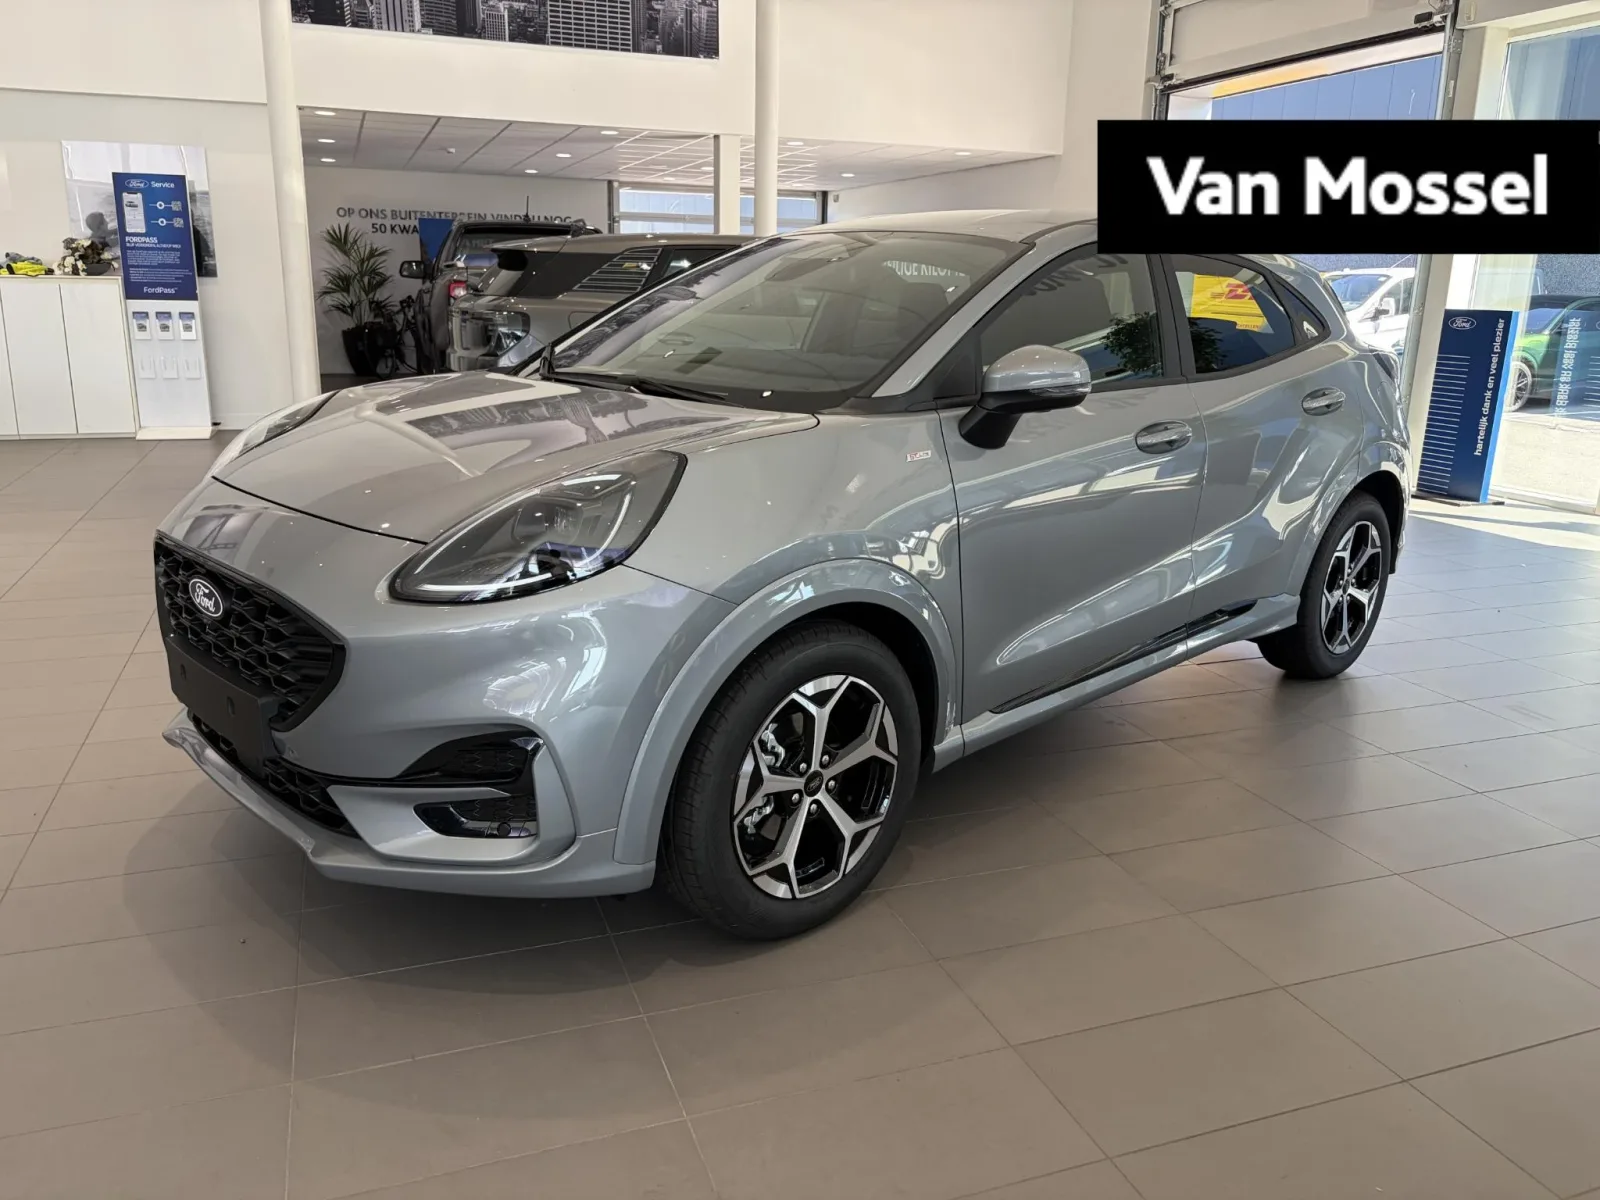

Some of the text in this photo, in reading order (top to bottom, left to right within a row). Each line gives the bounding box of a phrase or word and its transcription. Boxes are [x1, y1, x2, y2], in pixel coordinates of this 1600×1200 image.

[150, 181, 175, 189] Service
[336, 206, 355, 218] OP
[358, 208, 387, 220] ONS
[390, 209, 487, 221] BUITENTEREIN
[491, 213, 529, 221] VIND
[371, 222, 387, 234] 50
[125, 236, 158, 244] FORDPASS
[1452, 318, 1472, 328] Ford
[1473, 318, 1505, 456] hartelijk dank en veel plezier
[194, 582, 216, 613] Ford
